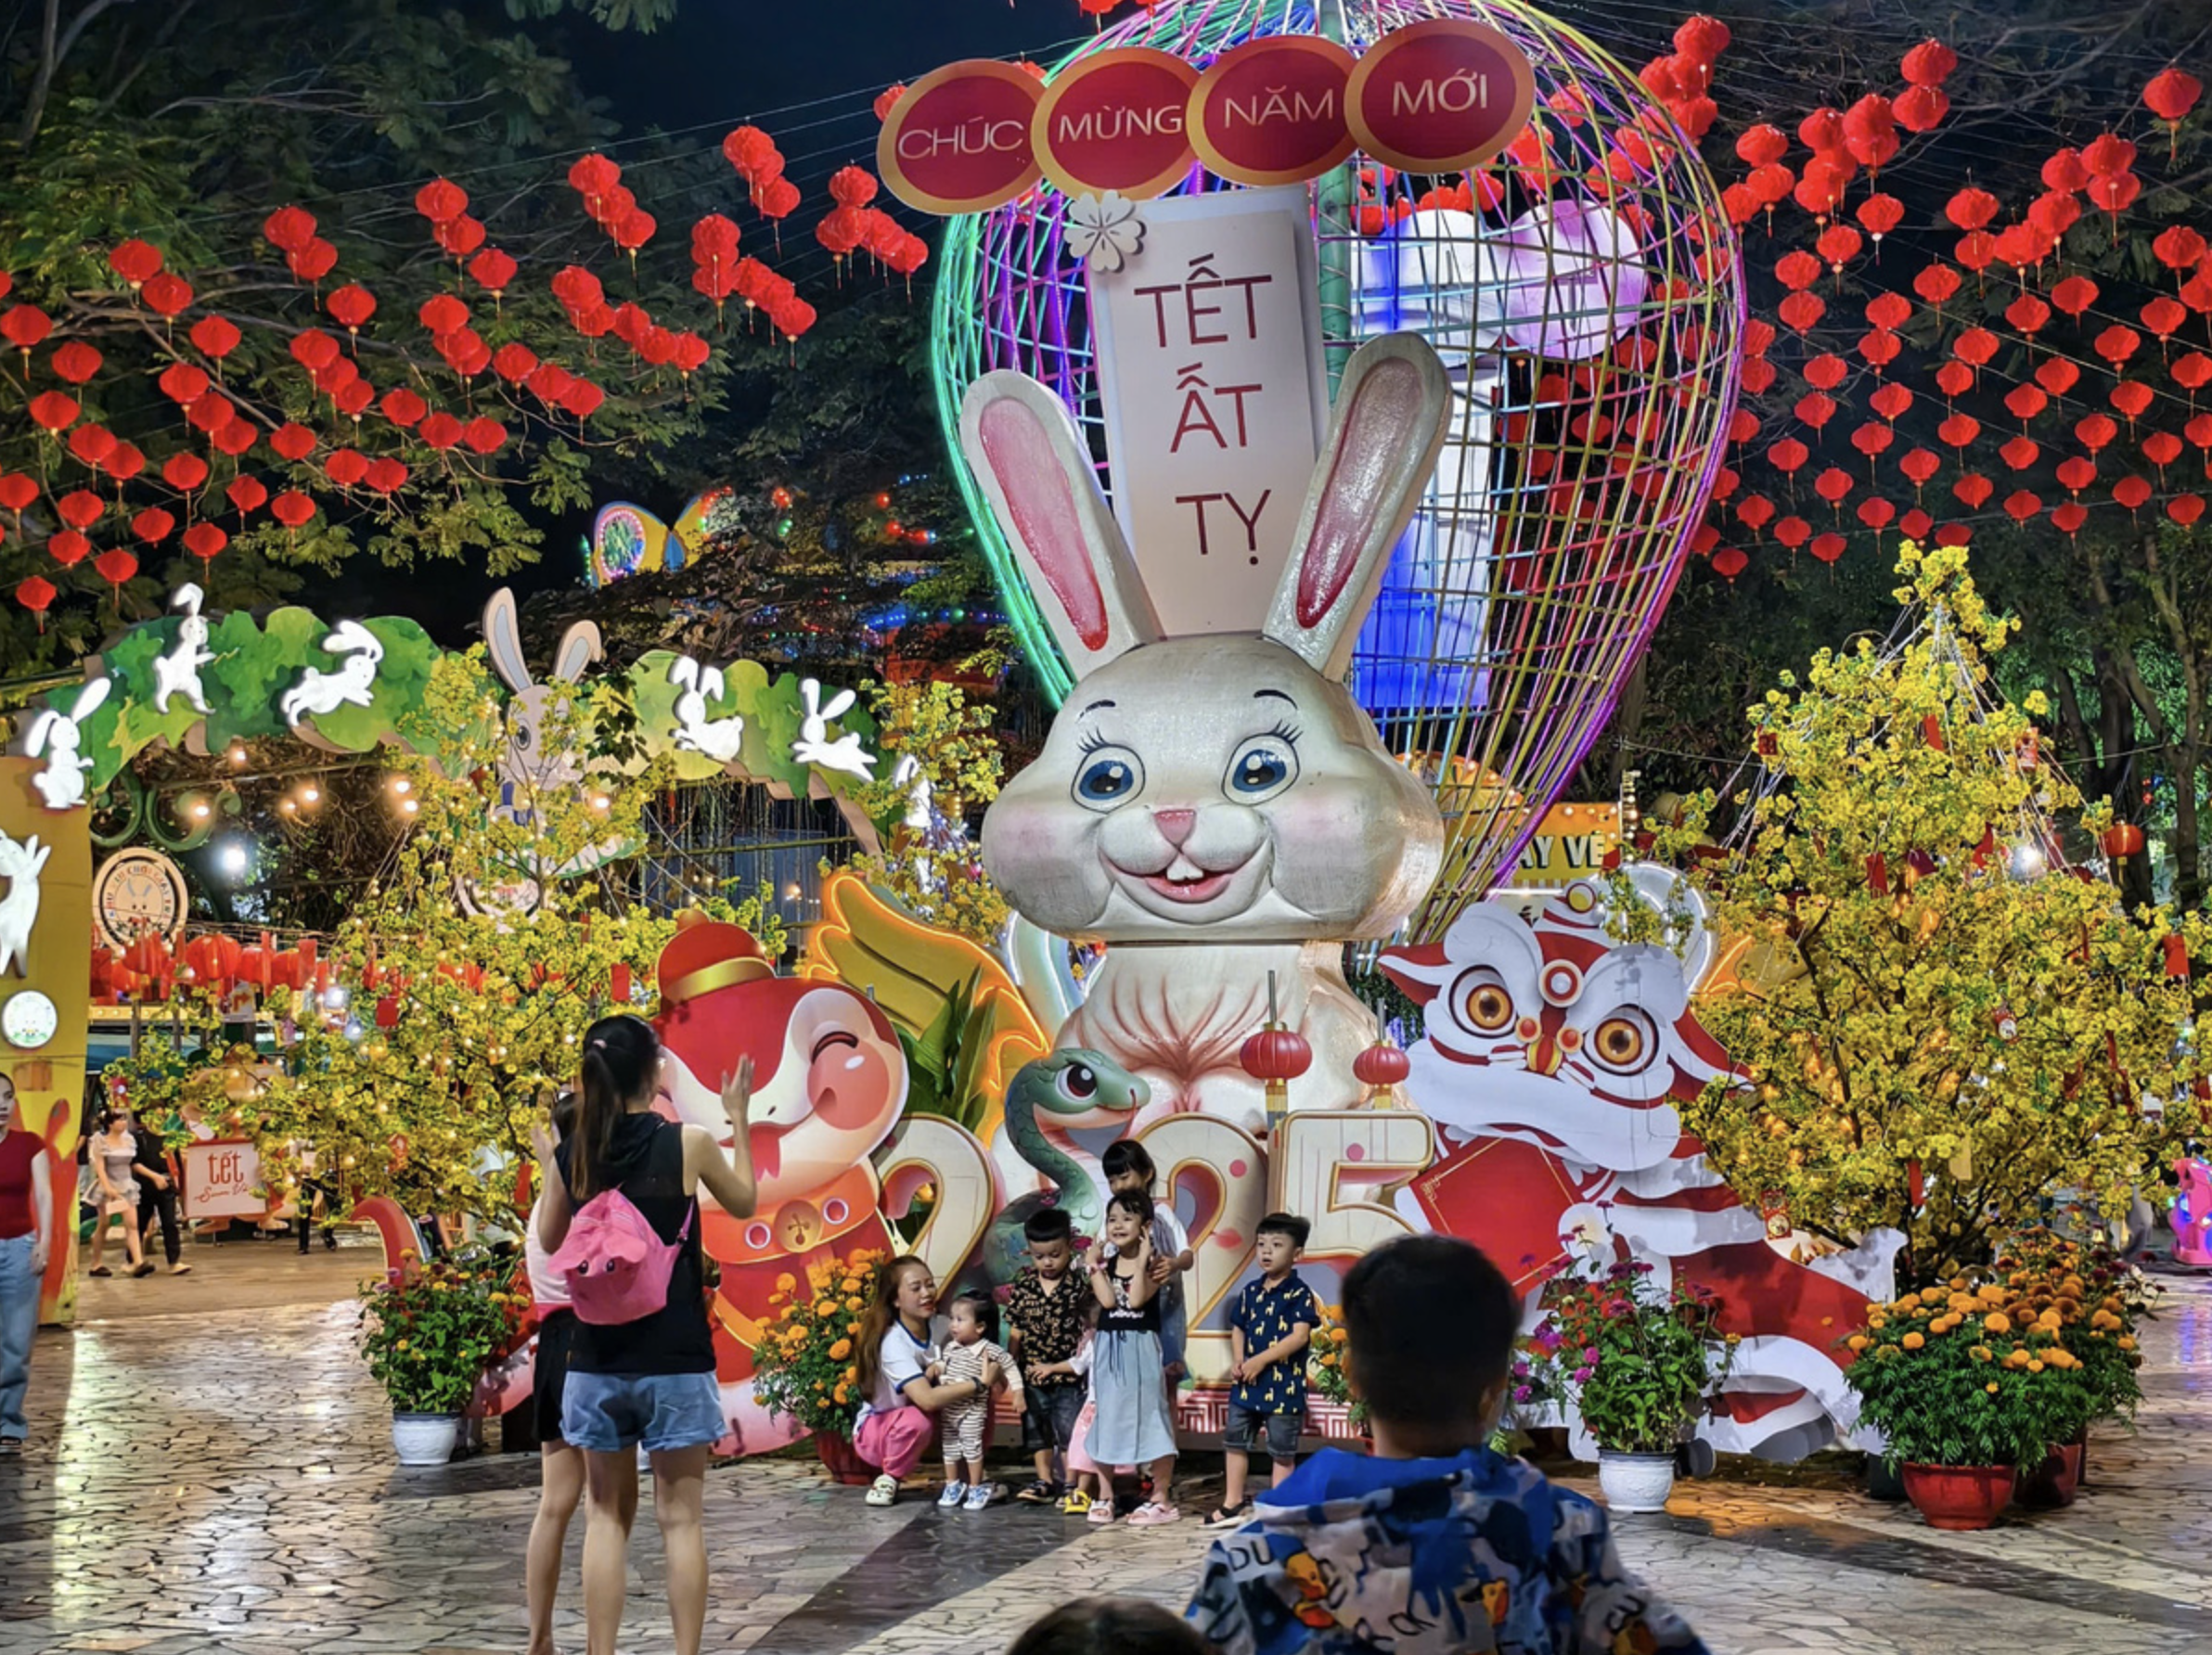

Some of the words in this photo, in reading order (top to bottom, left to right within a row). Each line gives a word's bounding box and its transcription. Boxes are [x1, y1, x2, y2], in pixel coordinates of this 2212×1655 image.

[897, 115, 1024, 160] CHÚC
[1059, 104, 1183, 144] MỪNG
[1224, 84, 1333, 129] NĂM
[1392, 68, 1487, 116] MỚI
[1134, 252, 1272, 348] TẾT
[1170, 361, 1263, 453] ẤT
[1175, 488, 1272, 566] TỴ
[207, 1150, 244, 1185] tết
